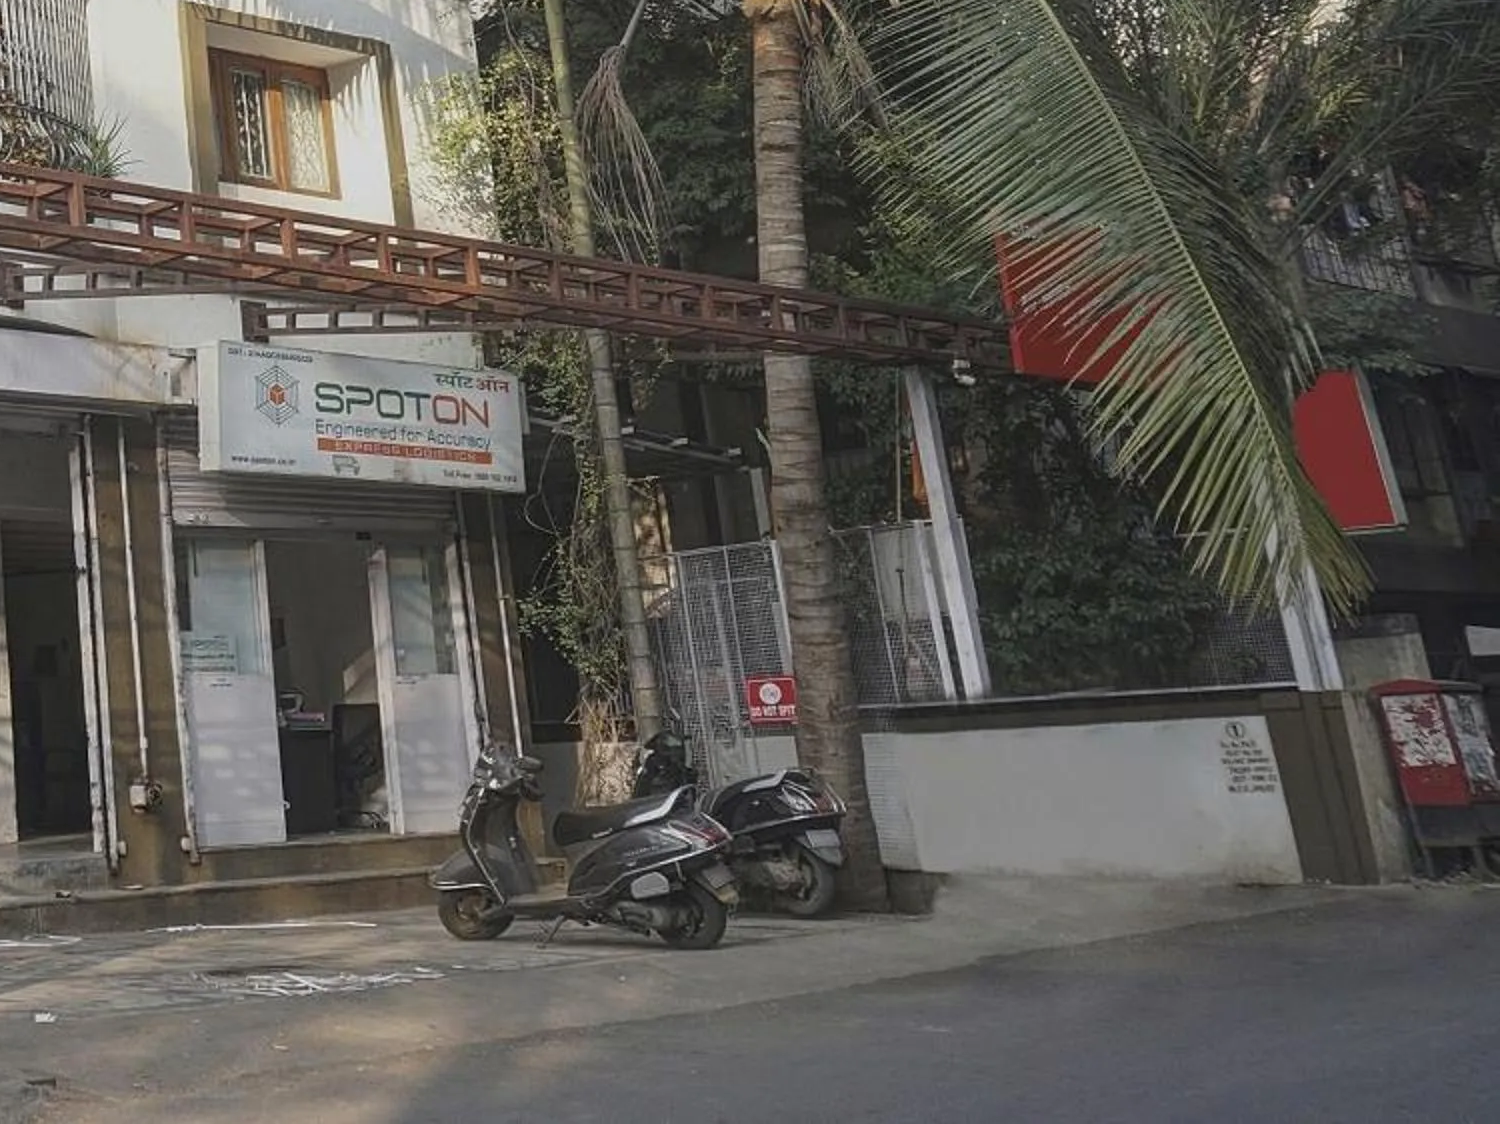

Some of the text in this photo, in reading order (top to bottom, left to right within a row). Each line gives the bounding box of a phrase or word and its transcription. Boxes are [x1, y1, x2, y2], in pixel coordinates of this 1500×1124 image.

[315, 382, 490, 428] SPOTON
[315, 419, 491, 451] Engineered for Accuracy
